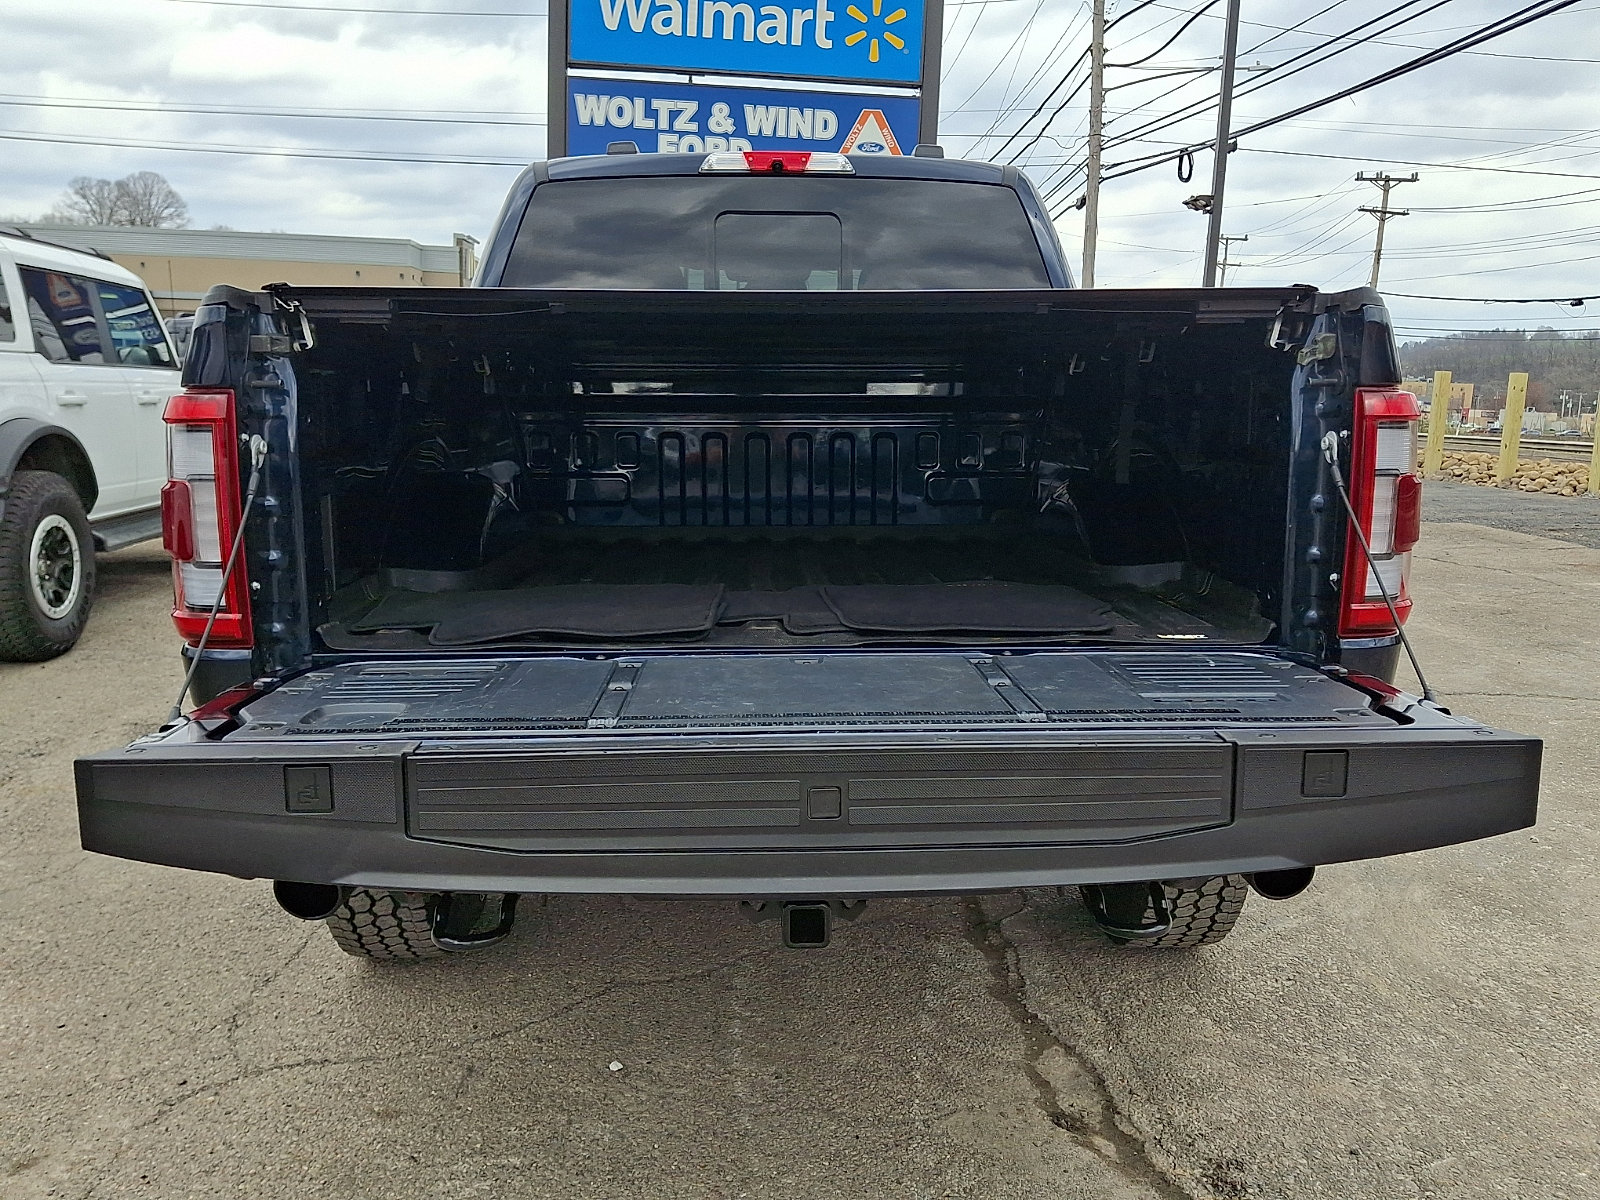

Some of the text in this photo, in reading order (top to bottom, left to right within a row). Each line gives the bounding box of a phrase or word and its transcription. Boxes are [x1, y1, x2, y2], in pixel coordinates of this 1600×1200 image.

[600, 0, 834, 49] Walmart
[574, 93, 838, 141] WOLTZ & WIND
[844, 123, 863, 149] WOLTZ
[860, 143, 881, 152] Ford
[881, 127, 895, 148] WIND
